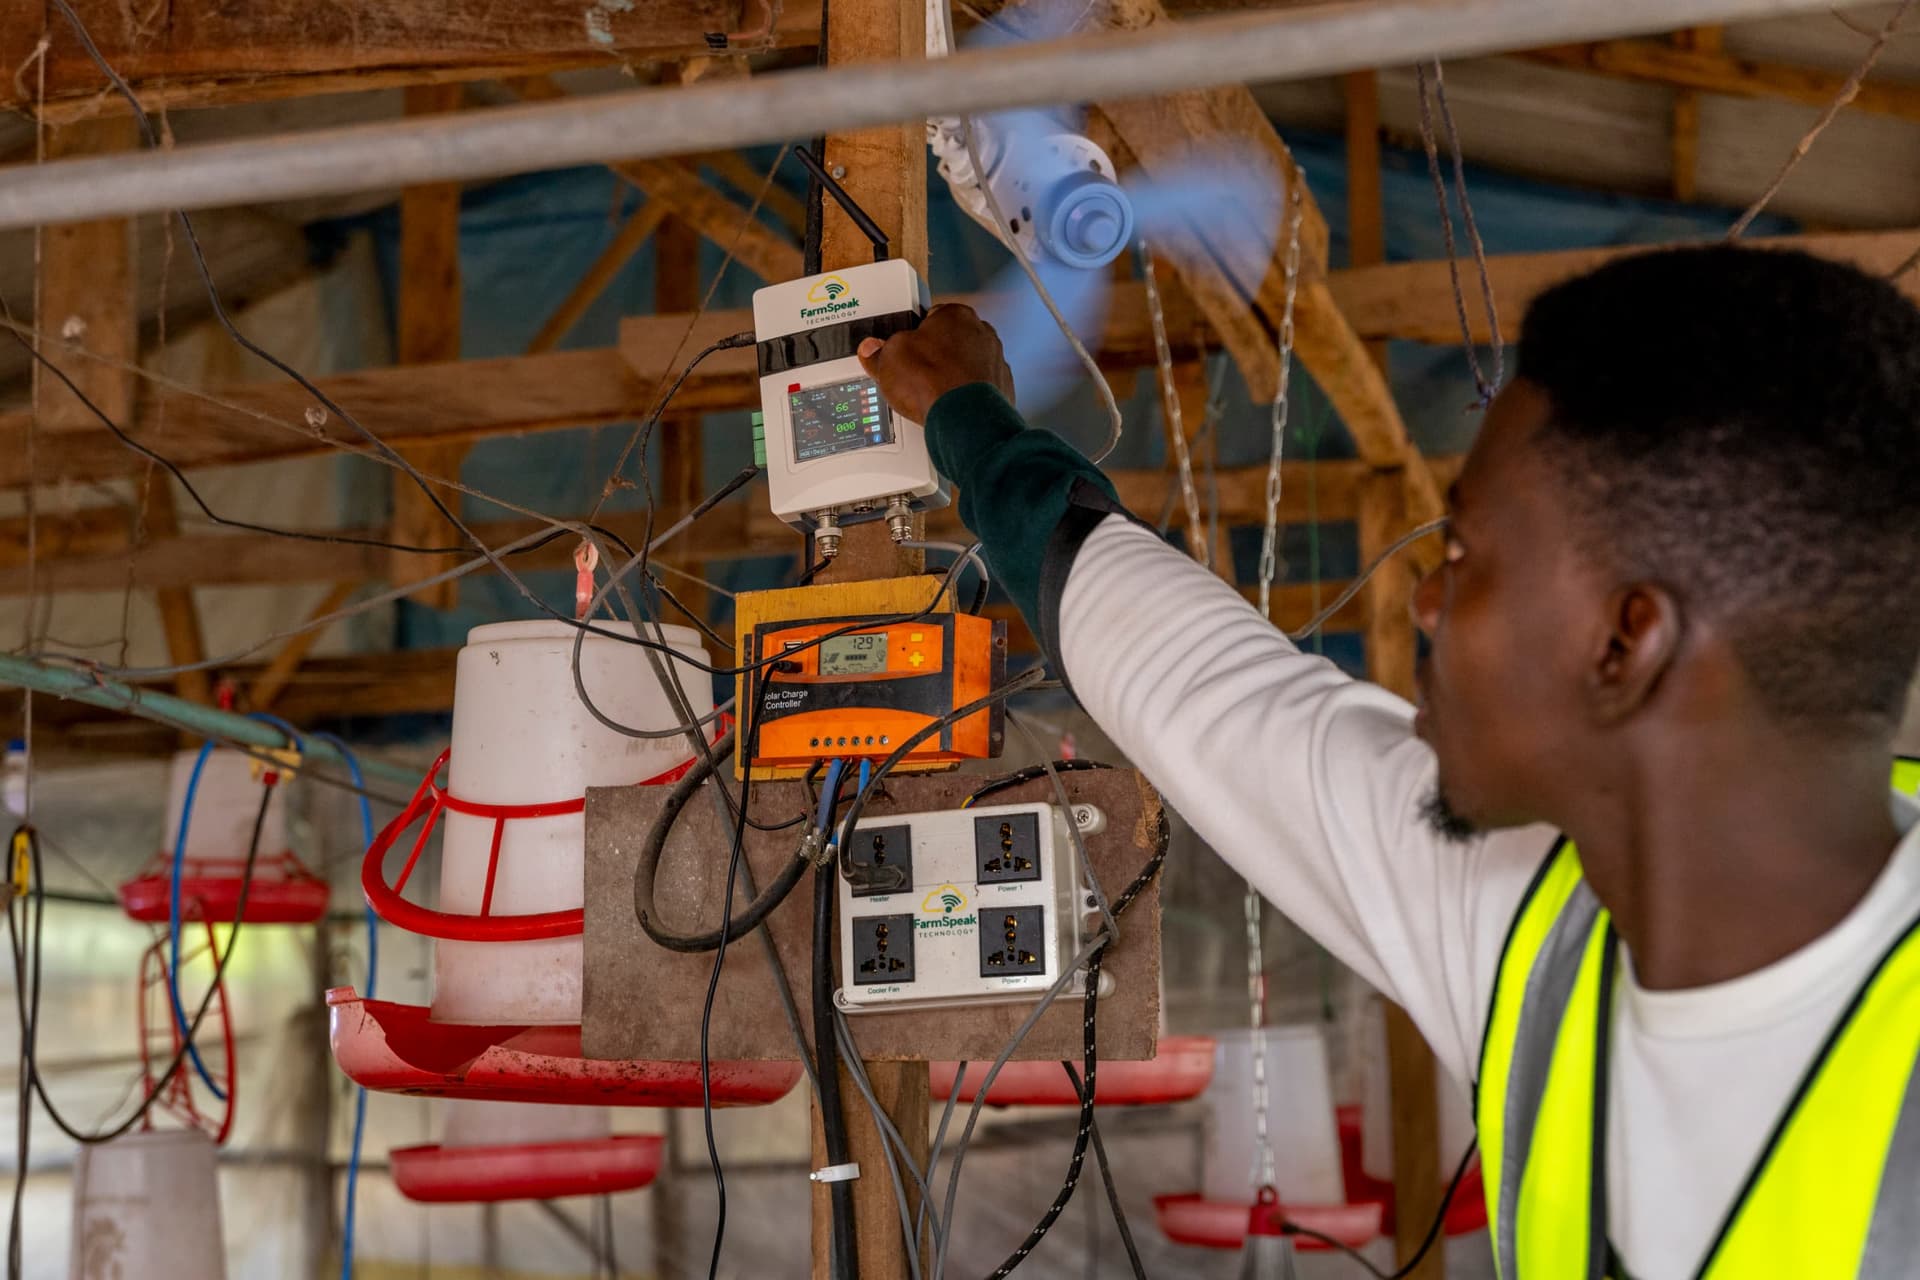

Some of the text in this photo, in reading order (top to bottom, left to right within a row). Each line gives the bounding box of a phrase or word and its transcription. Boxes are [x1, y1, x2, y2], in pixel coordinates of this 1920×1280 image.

[800, 297, 860, 319] FarmSpeak
[806, 310, 857, 325] TECHNOLOGY
[835, 401, 849, 413] 66
[781, 690, 808, 699] Charge
[765, 699, 801, 710] Controller
[913, 914, 977, 929] FarmSpeak
[919, 929, 974, 938] TECHNOLOGY
